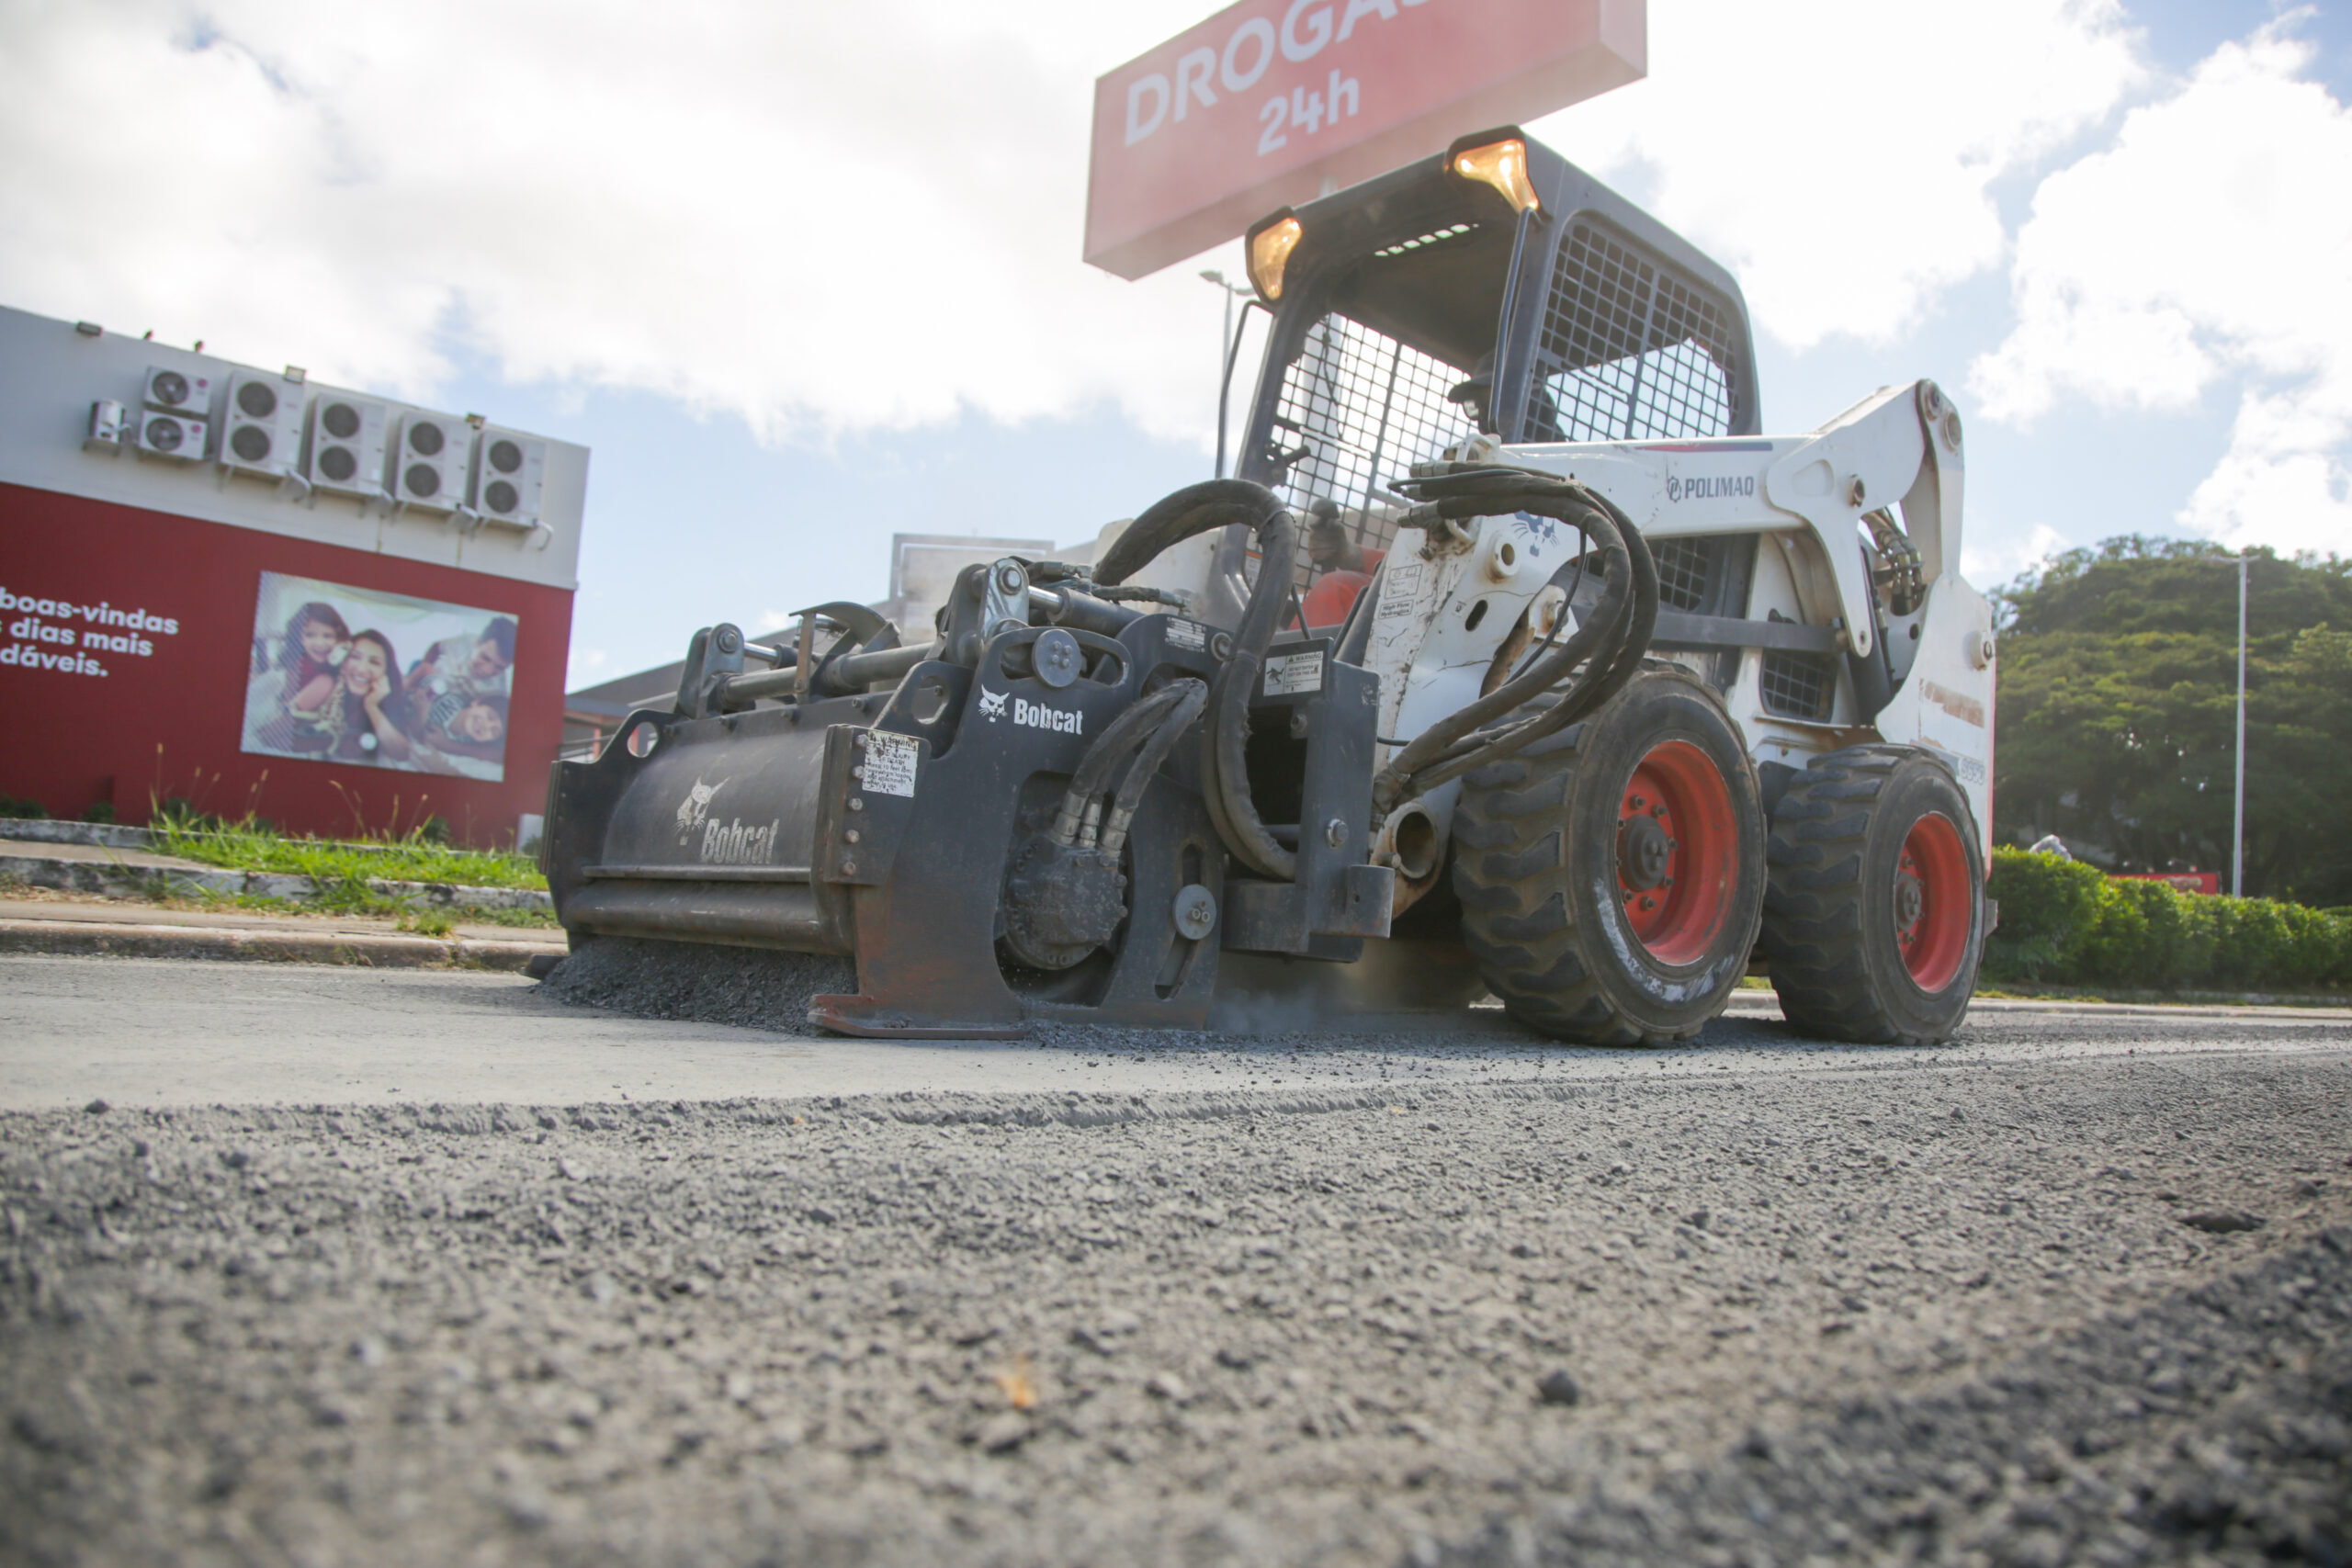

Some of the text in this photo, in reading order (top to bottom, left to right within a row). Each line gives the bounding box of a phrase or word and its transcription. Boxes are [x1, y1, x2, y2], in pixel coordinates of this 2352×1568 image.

[1125, 0, 1427, 148] DROGA
[1257, 68, 1360, 157] 24h
[1685, 476, 1755, 499] POLIMAQ
[0, 586, 179, 635] boas-vindas
[9, 616, 76, 645] dias
[83, 631, 154, 657] mais
[1013, 698, 1083, 736] Bobcat
[701, 818, 780, 864] Bobcat
